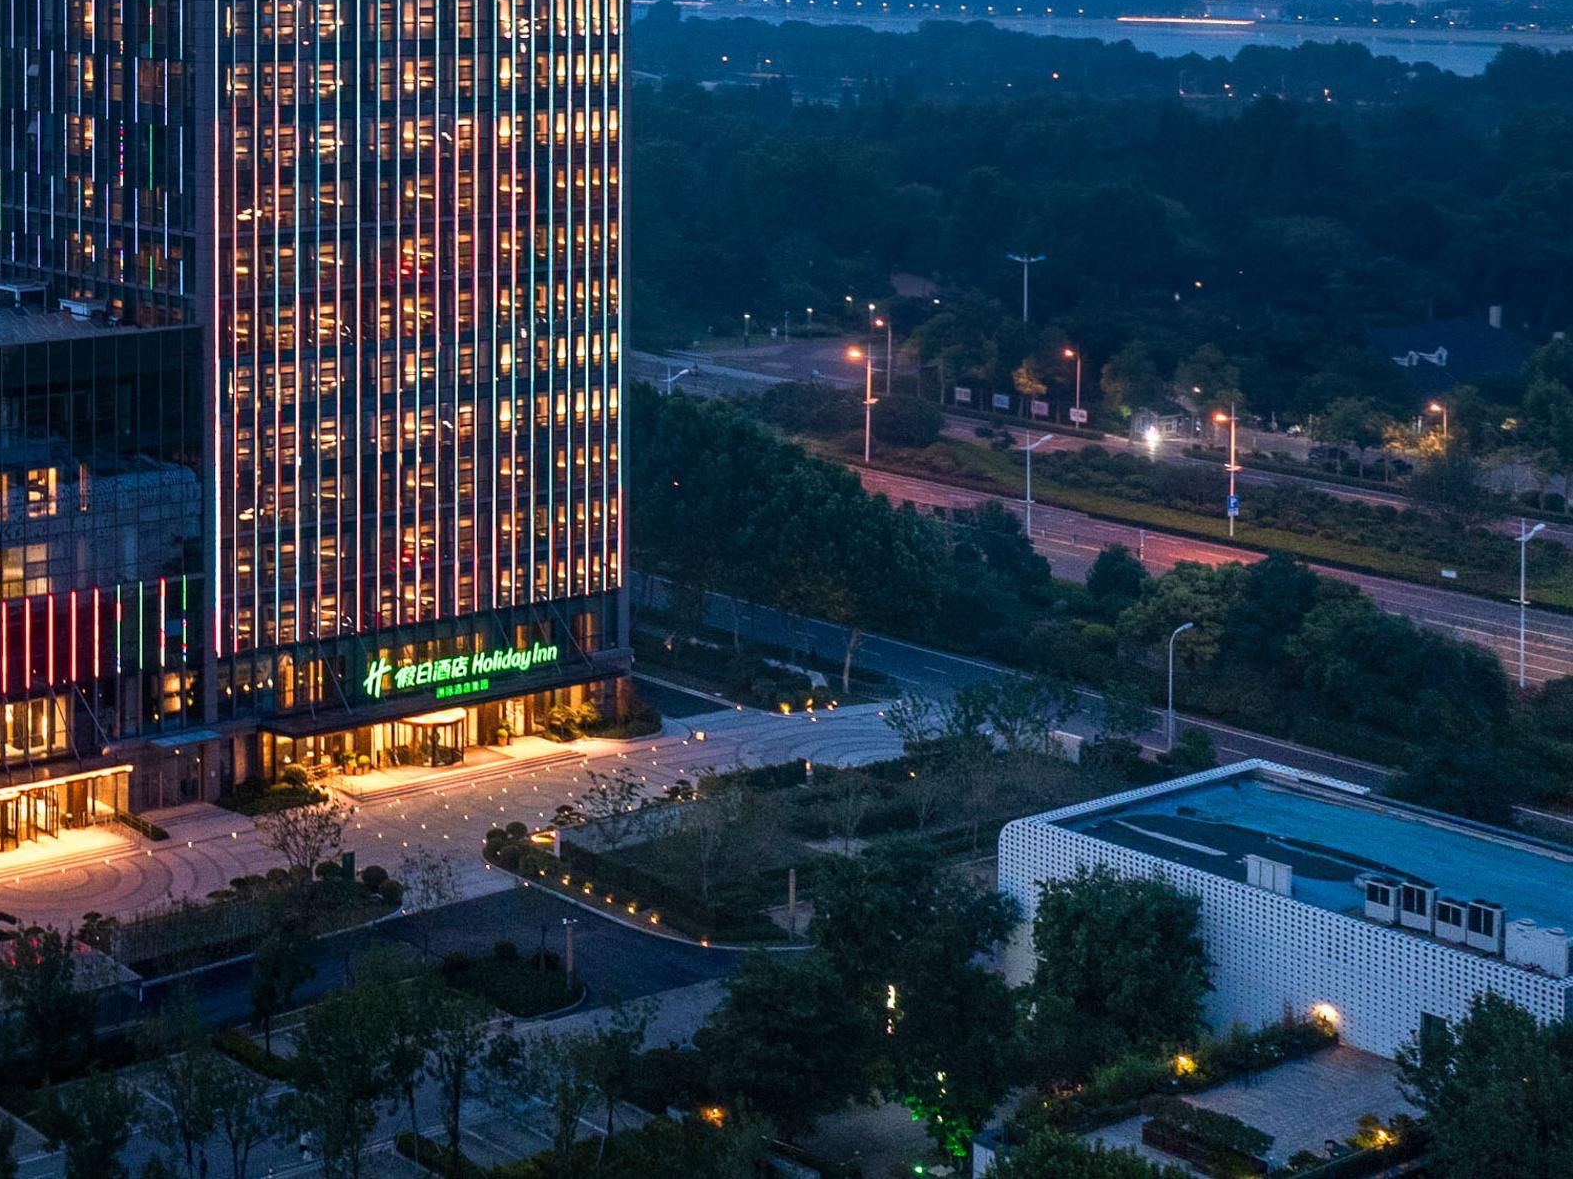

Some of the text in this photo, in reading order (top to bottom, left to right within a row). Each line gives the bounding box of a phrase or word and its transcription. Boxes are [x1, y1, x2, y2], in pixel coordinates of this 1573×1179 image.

[394, 655, 469, 690] 假日酒店
[471, 644, 532, 676] Holiday
[532, 641, 558, 664] Inn
